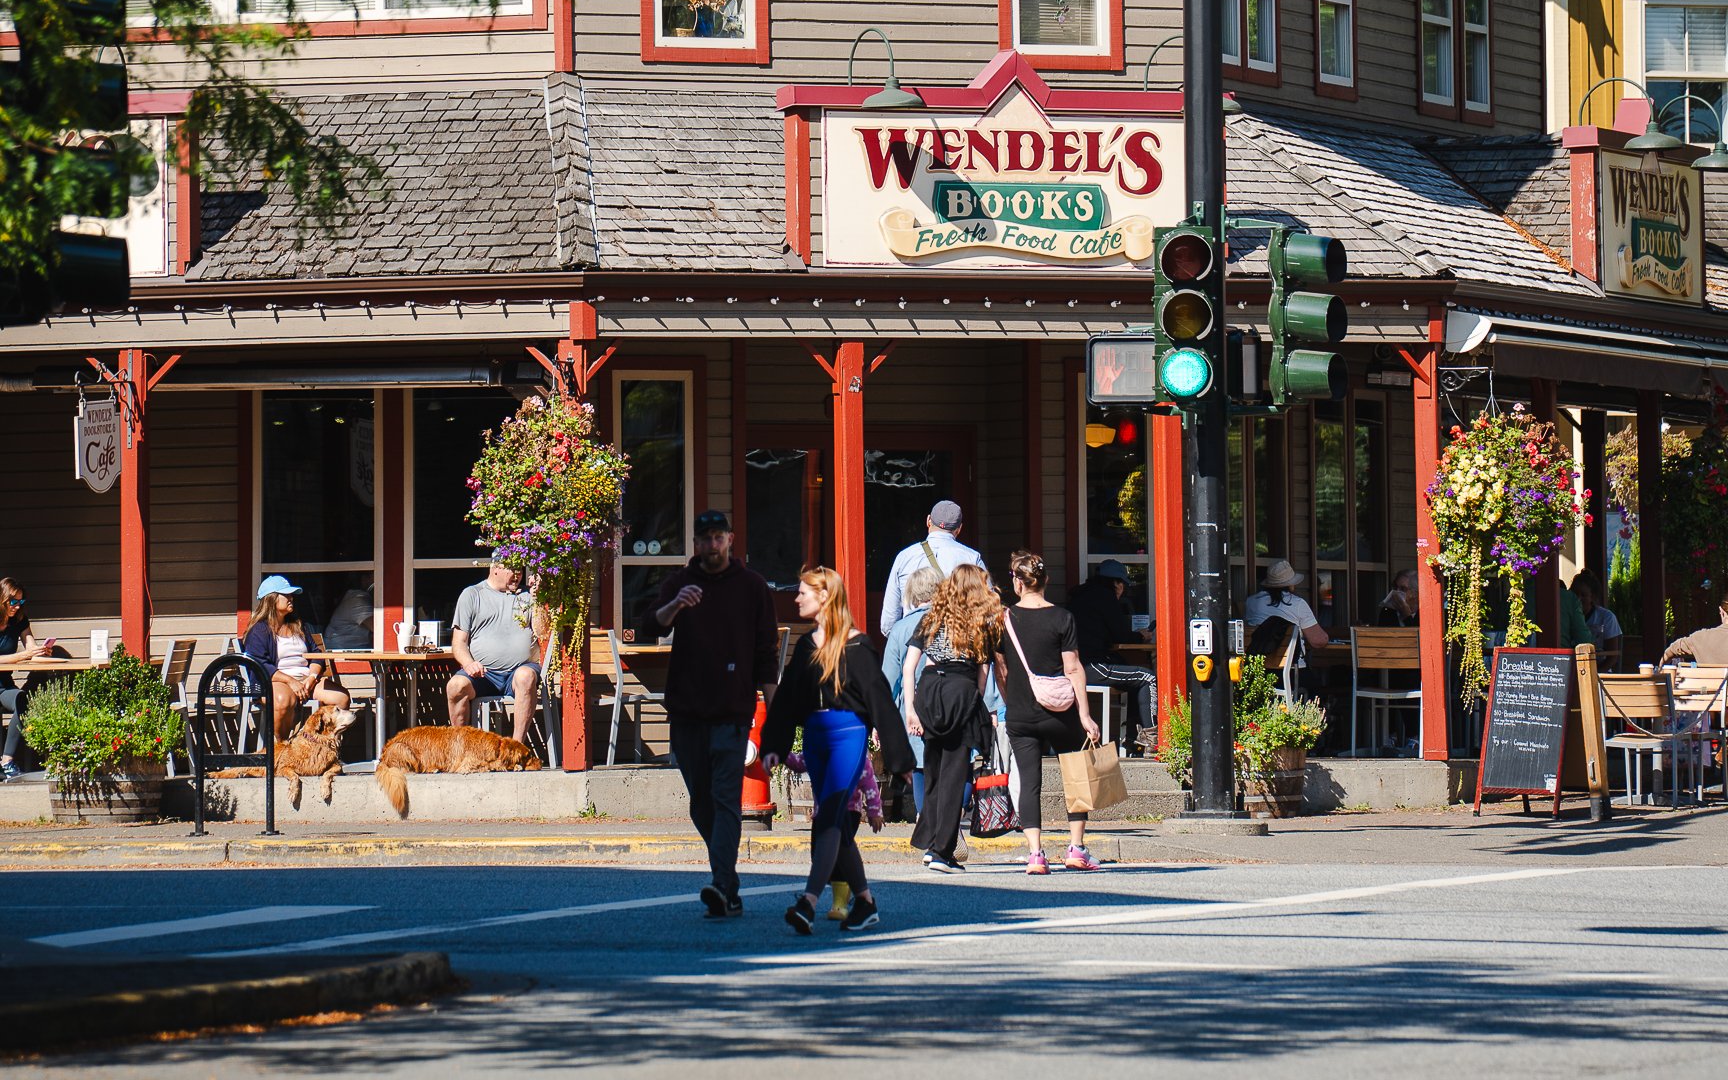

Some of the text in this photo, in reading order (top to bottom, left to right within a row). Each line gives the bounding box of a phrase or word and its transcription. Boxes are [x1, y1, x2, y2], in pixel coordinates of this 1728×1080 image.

[853, 126, 1164, 195] WENDEL'S
[946, 189, 1095, 221] BOOKS
[1609, 166, 1690, 238] WENDEL'S
[914, 222, 988, 252] Fresh
[1001, 225, 1056, 251] Food
[1640, 227, 1679, 259] BOOKS
[1632, 263, 1651, 282] Fresh
[1654, 263, 1669, 285] Food
[1502, 657, 1560, 674] Breakfast Specials
[1527, 711, 1550, 722] Sandwich
